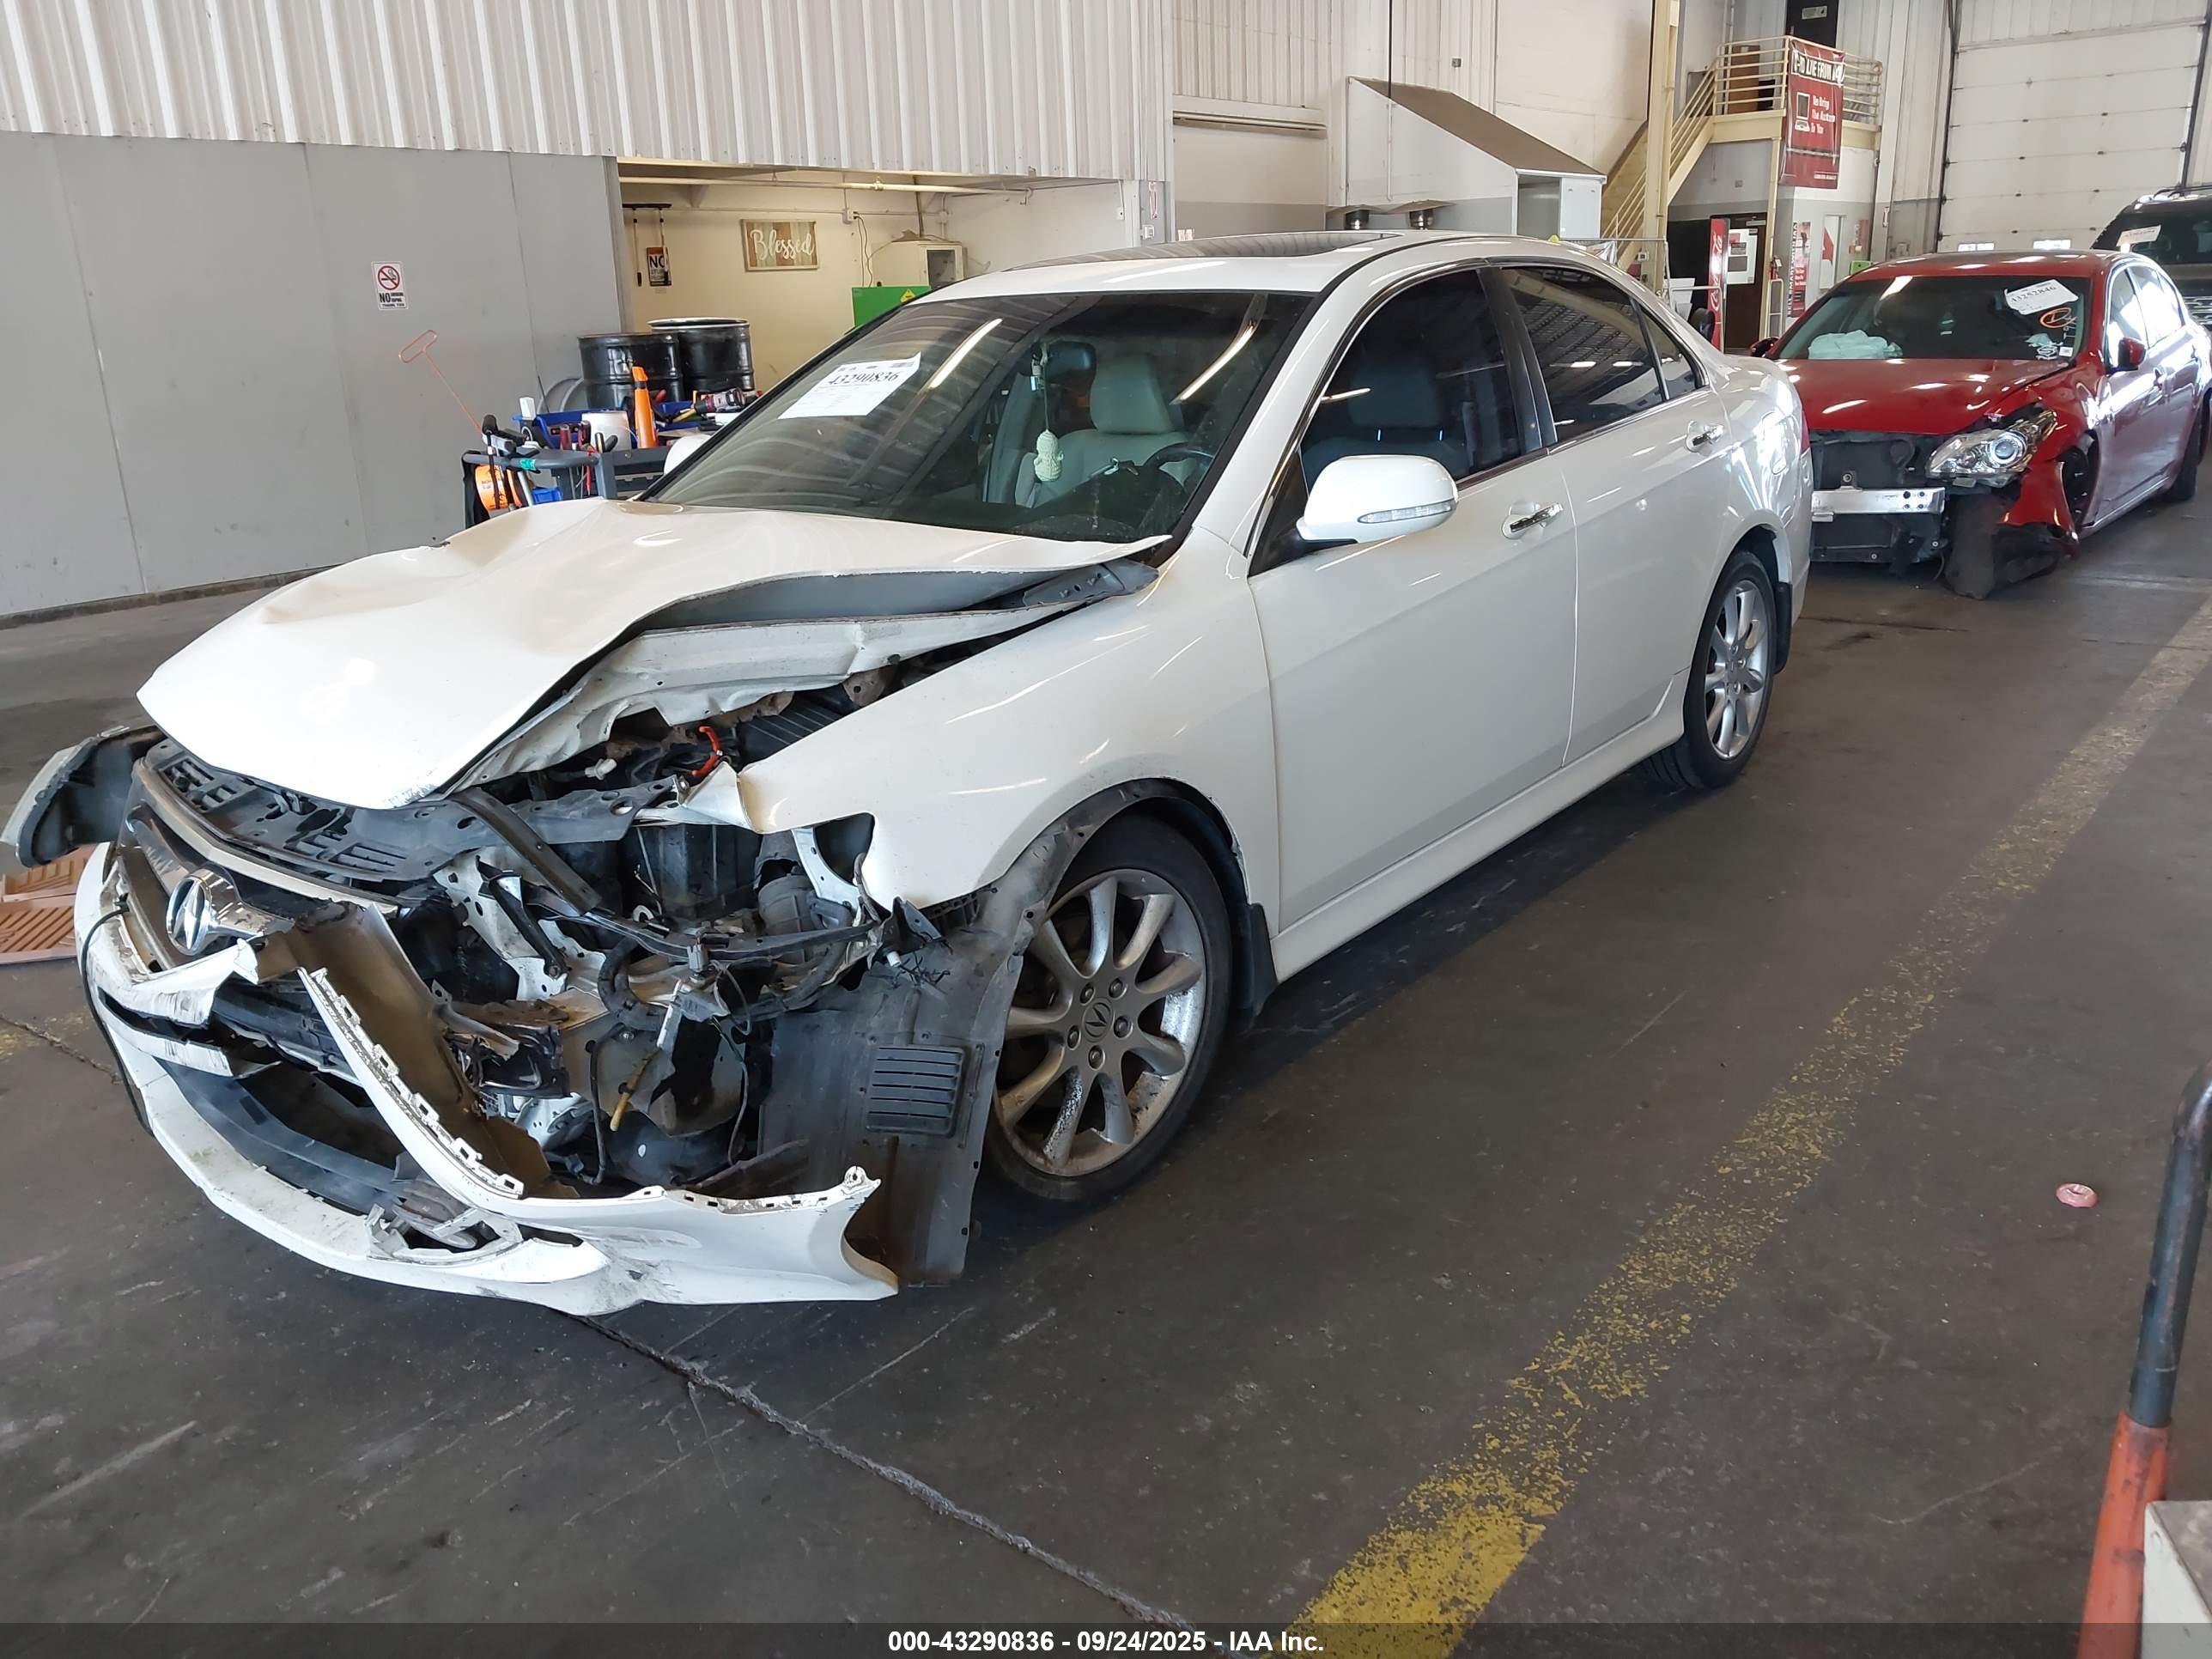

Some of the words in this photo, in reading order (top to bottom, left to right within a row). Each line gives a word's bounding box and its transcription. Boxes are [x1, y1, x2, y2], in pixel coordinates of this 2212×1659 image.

[750, 228, 815, 261] Blessed
[379, 292, 391, 302] NO
[829, 371, 900, 385] 43290836
